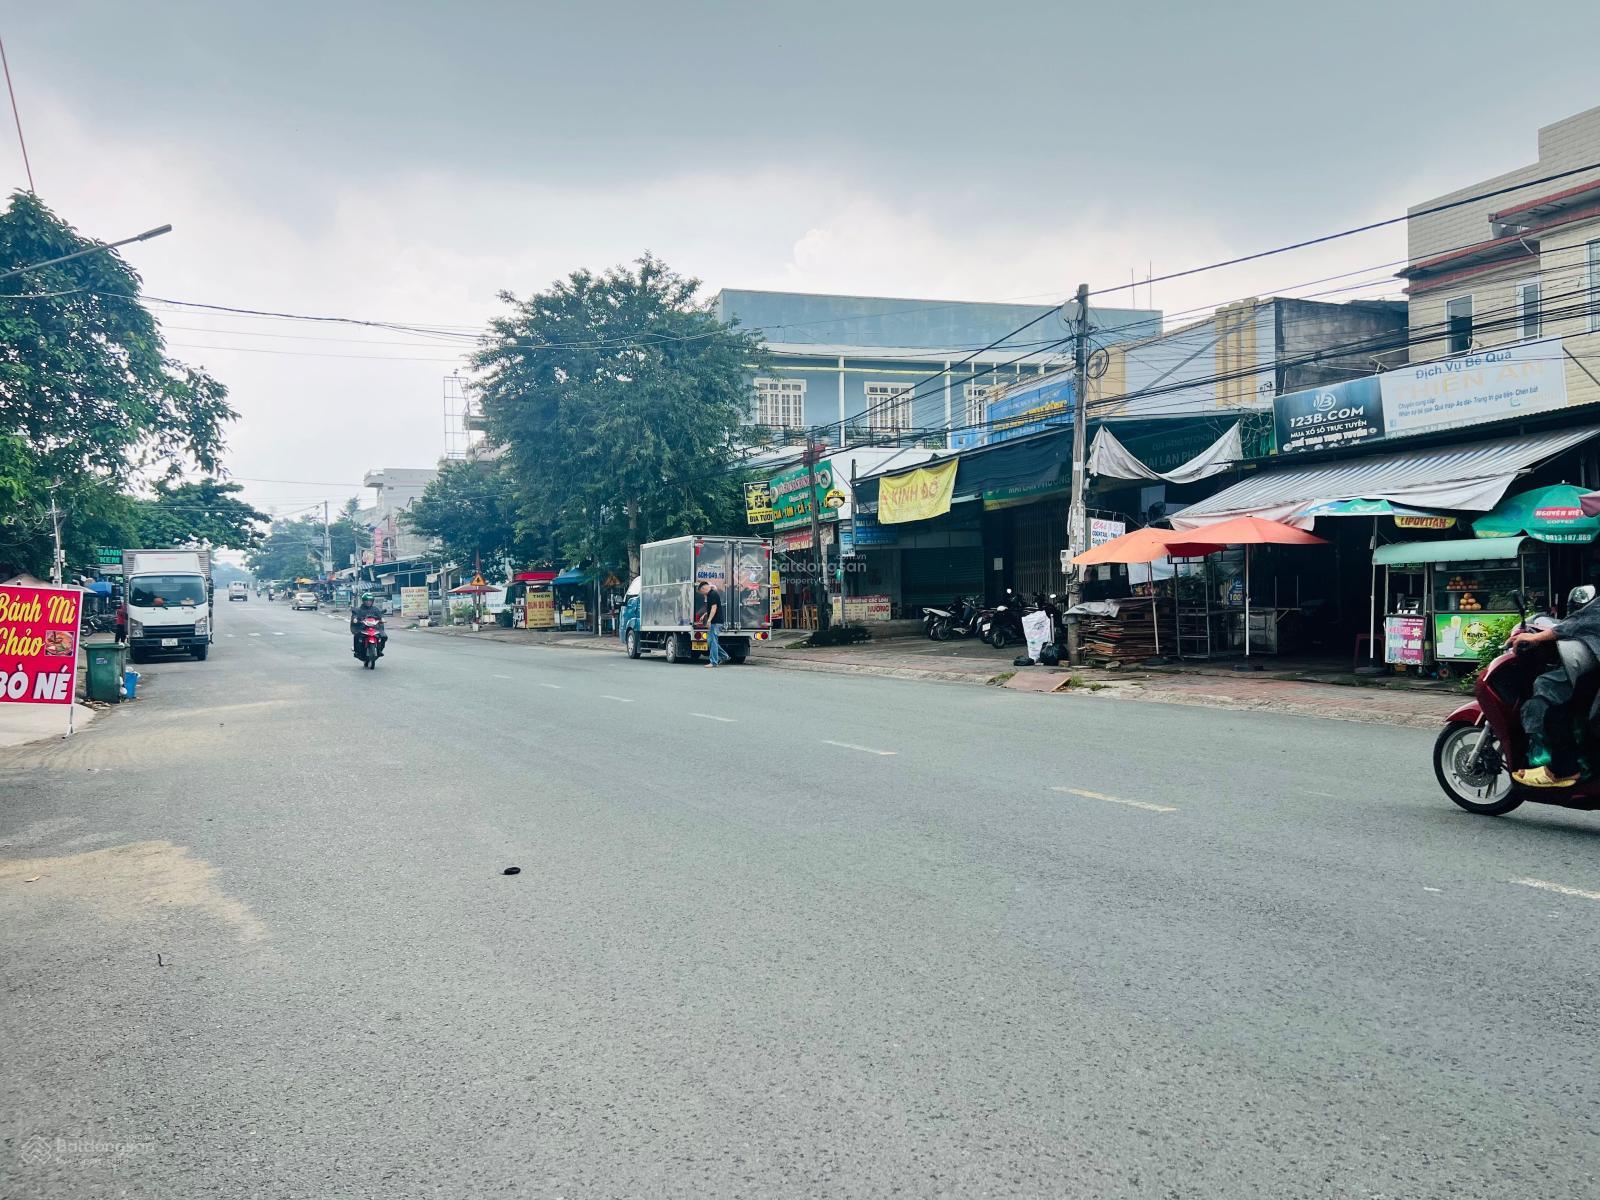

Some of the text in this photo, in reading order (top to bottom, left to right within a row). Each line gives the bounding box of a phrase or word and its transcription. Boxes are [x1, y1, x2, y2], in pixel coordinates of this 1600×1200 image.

[1415, 366, 1442, 380] Dịch
[1445, 362, 1462, 373] Vụ
[1289, 405, 1364, 428] 123B.COM
[32, 664, 72, 700] NÉ
